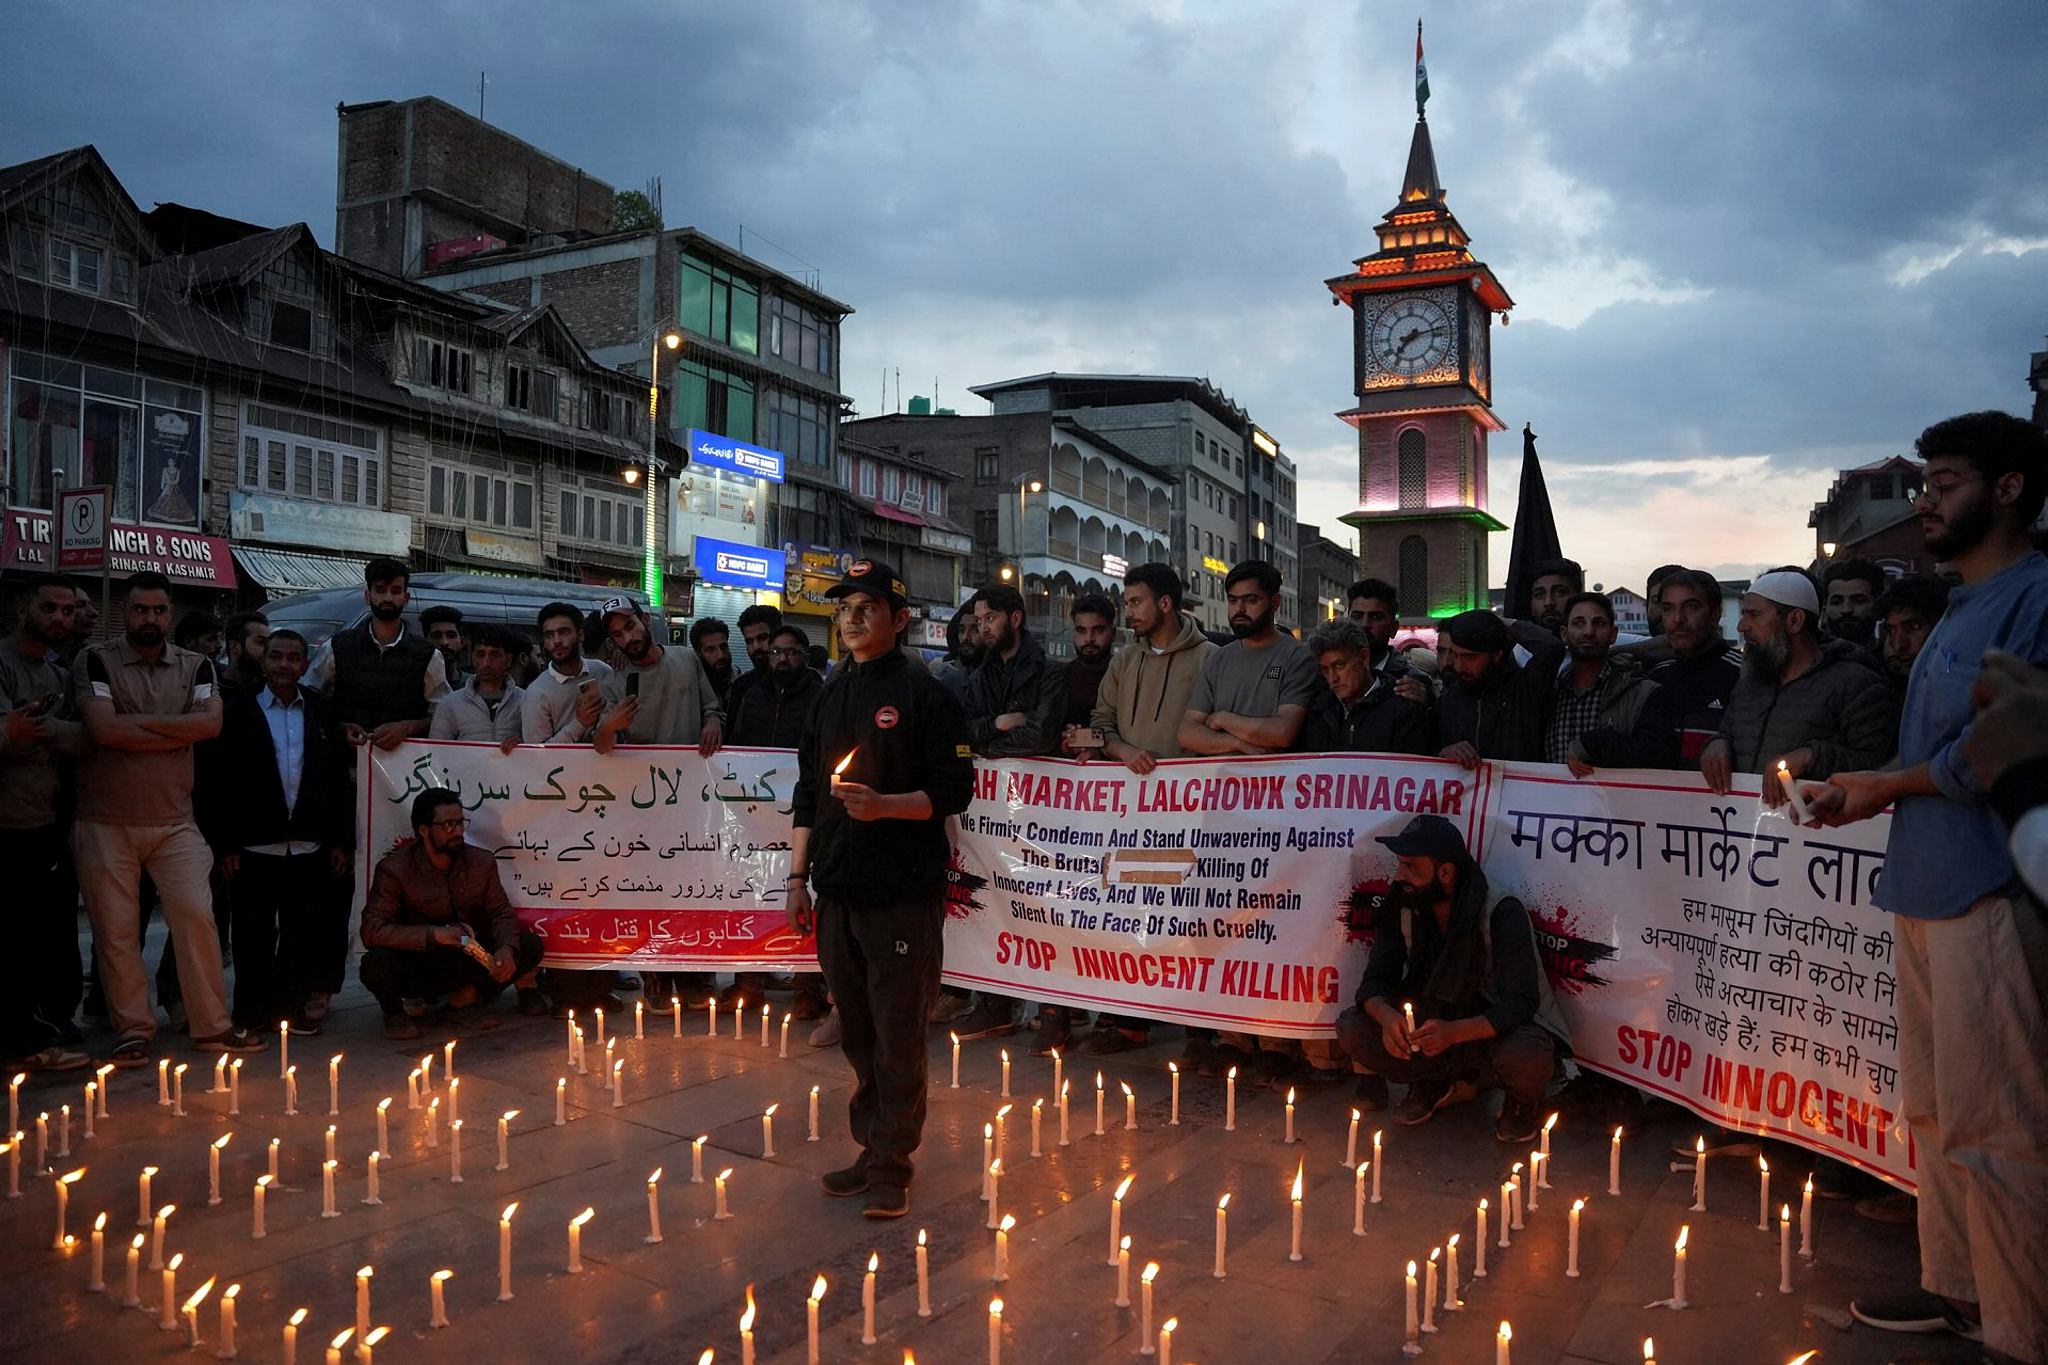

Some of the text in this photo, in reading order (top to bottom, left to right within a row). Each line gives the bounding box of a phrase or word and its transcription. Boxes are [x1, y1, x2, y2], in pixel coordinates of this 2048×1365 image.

[64, 536, 101, 547] NO PARKING
[155, 535, 167, 557] &
[171, 537, 212, 563] SONS
[18, 547, 45, 563] LAL
[166, 562, 216, 581] KASHMIR
[673, 630, 681, 641] P
[524, 766, 616, 819] چوک
[632, 763, 683, 809] لال
[1007, 771, 1127, 818] MARKET,
[1137, 775, 1286, 813] LALCHOWK
[1294, 774, 1463, 817] SRINAGAR
[557, 831, 596, 862] کے
[604, 834, 651, 858] خون
[659, 832, 721, 859] انسانی
[960, 812, 976, 832] We
[1026, 822, 1104, 849] Condemn
[1109, 826, 1139, 848] And
[1143, 827, 1186, 849] Stand
[1190, 827, 1283, 853] Unwavering
[1287, 826, 1355, 852] Against
[1507, 809, 1646, 870] मक्का
[1656, 806, 1790, 888] मार्केट
[1021, 849, 1050, 869] The
[1197, 856, 1246, 881] Killing
[1250, 857, 1269, 878] Of
[560, 875, 610, 901] کرتے
[617, 875, 664, 893] مذمت
[670, 879, 724, 900] پرزور
[993, 870, 1051, 897] Innocent
[1106, 885, 1136, 906] And
[1142, 886, 1165, 907] We
[1171, 887, 1200, 909] Will
[1205, 887, 1232, 909] Not
[1237, 888, 1302, 912] Remain
[559, 920, 591, 944] بند
[600, 917, 639, 943] قتل
[681, 914, 755, 950] گناہوں
[1010, 900, 1278, 945] Silent In The Face Of Such Cruelty.
[1682, 898, 1895, 964] हम मासूम जिंदगियों की
[996, 931, 1340, 1005] STOP INNOCENT KILLING
[1720, 943, 1762, 973] हत्या
[1768, 949, 1803, 981] की
[1808, 961, 1869, 999] कठोर
[1695, 967, 1899, 1051] ऐसे अत्याचार के सामने
[1665, 992, 1702, 1030] होकर
[1770, 1030, 1809, 1061] हम
[1812, 1041, 1861, 1079] कभी
[1617, 1025, 1693, 1083] STOP
[1702, 1053, 1895, 1158] INNOCENT
